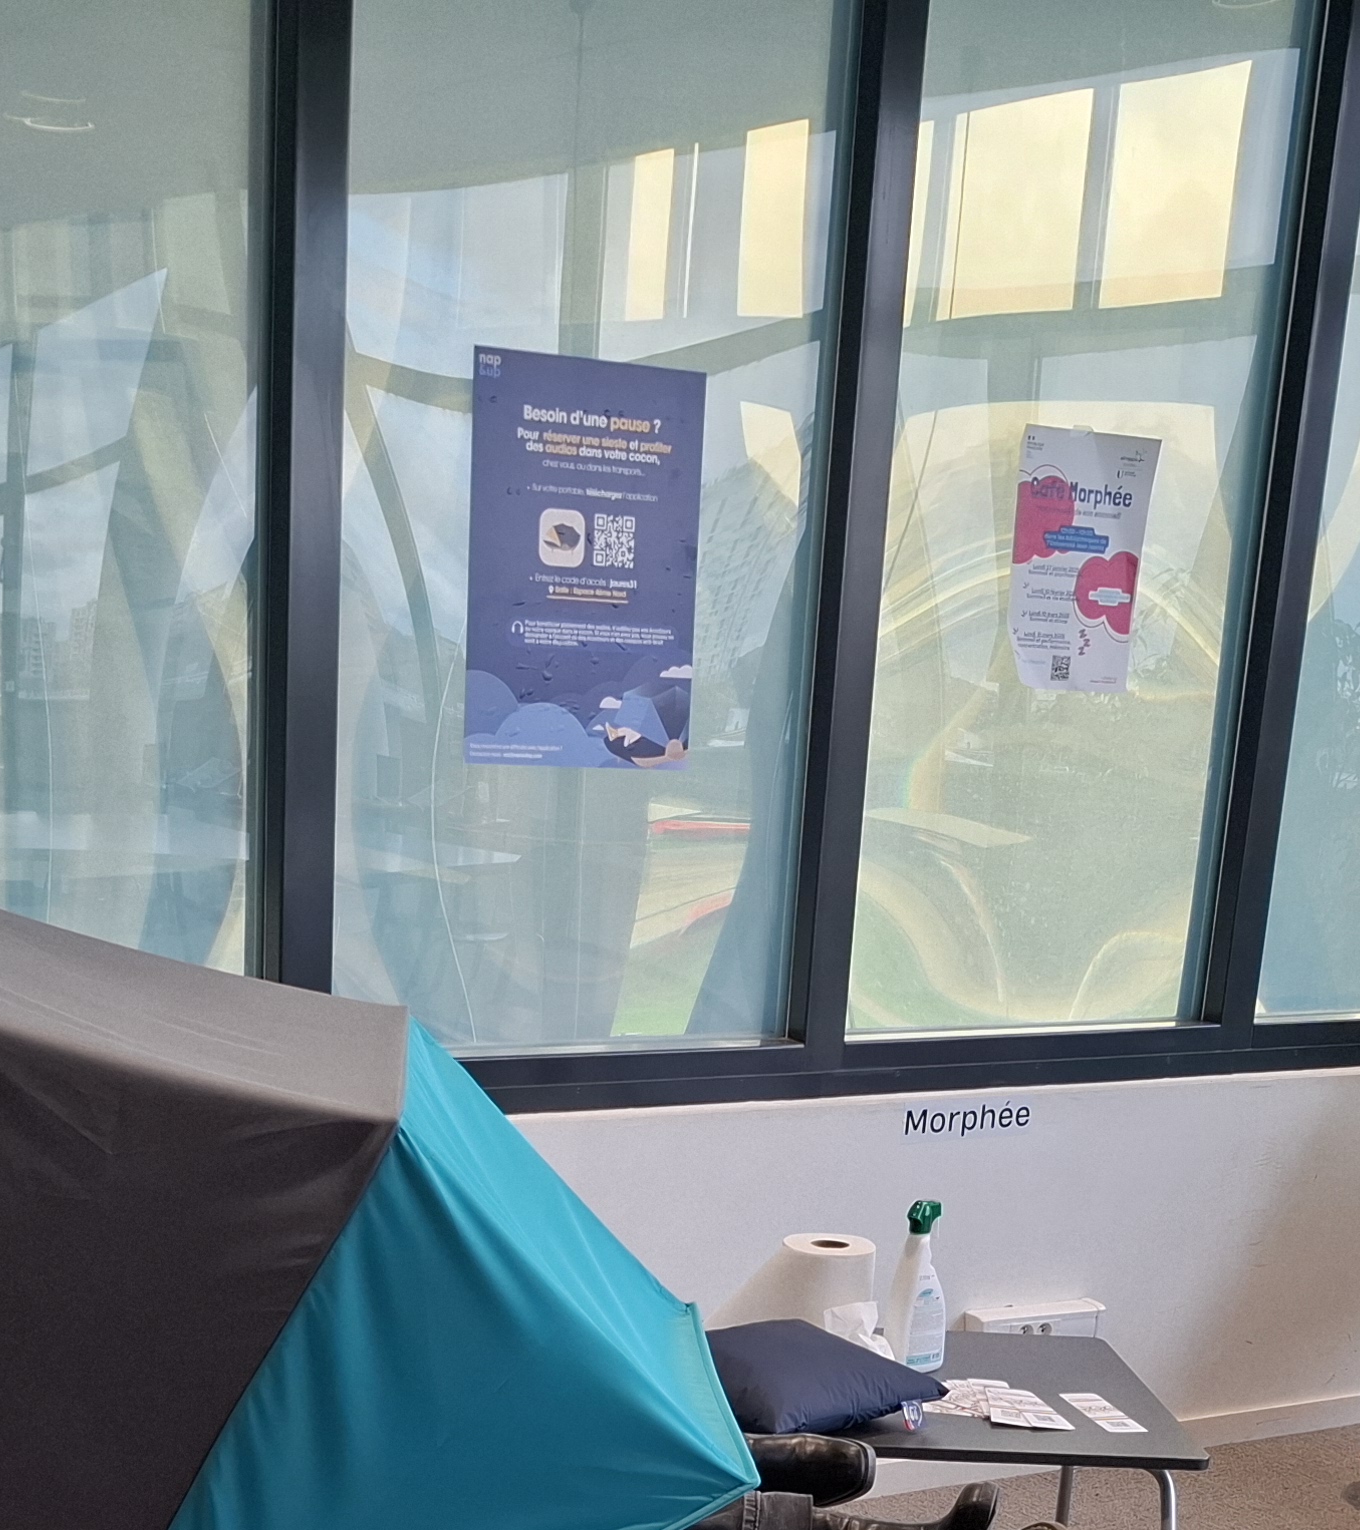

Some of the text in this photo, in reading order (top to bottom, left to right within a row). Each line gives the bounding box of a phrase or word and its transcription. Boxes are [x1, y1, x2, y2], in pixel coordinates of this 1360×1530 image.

[479, 353, 501, 366] nap
[523, 404, 661, 434] Besoin d'une pause ?
[517, 427, 539, 440] Pour
[582, 435, 600, 446] une
[629, 439, 639, 451] et
[526, 440, 543, 452] des
[579, 446, 602, 459] dans
[604, 449, 627, 461] votre
[629, 452, 660, 465] cocon,
[1069, 481, 1133, 510] Morphée
[904, 1100, 1030, 1137] Morphée
